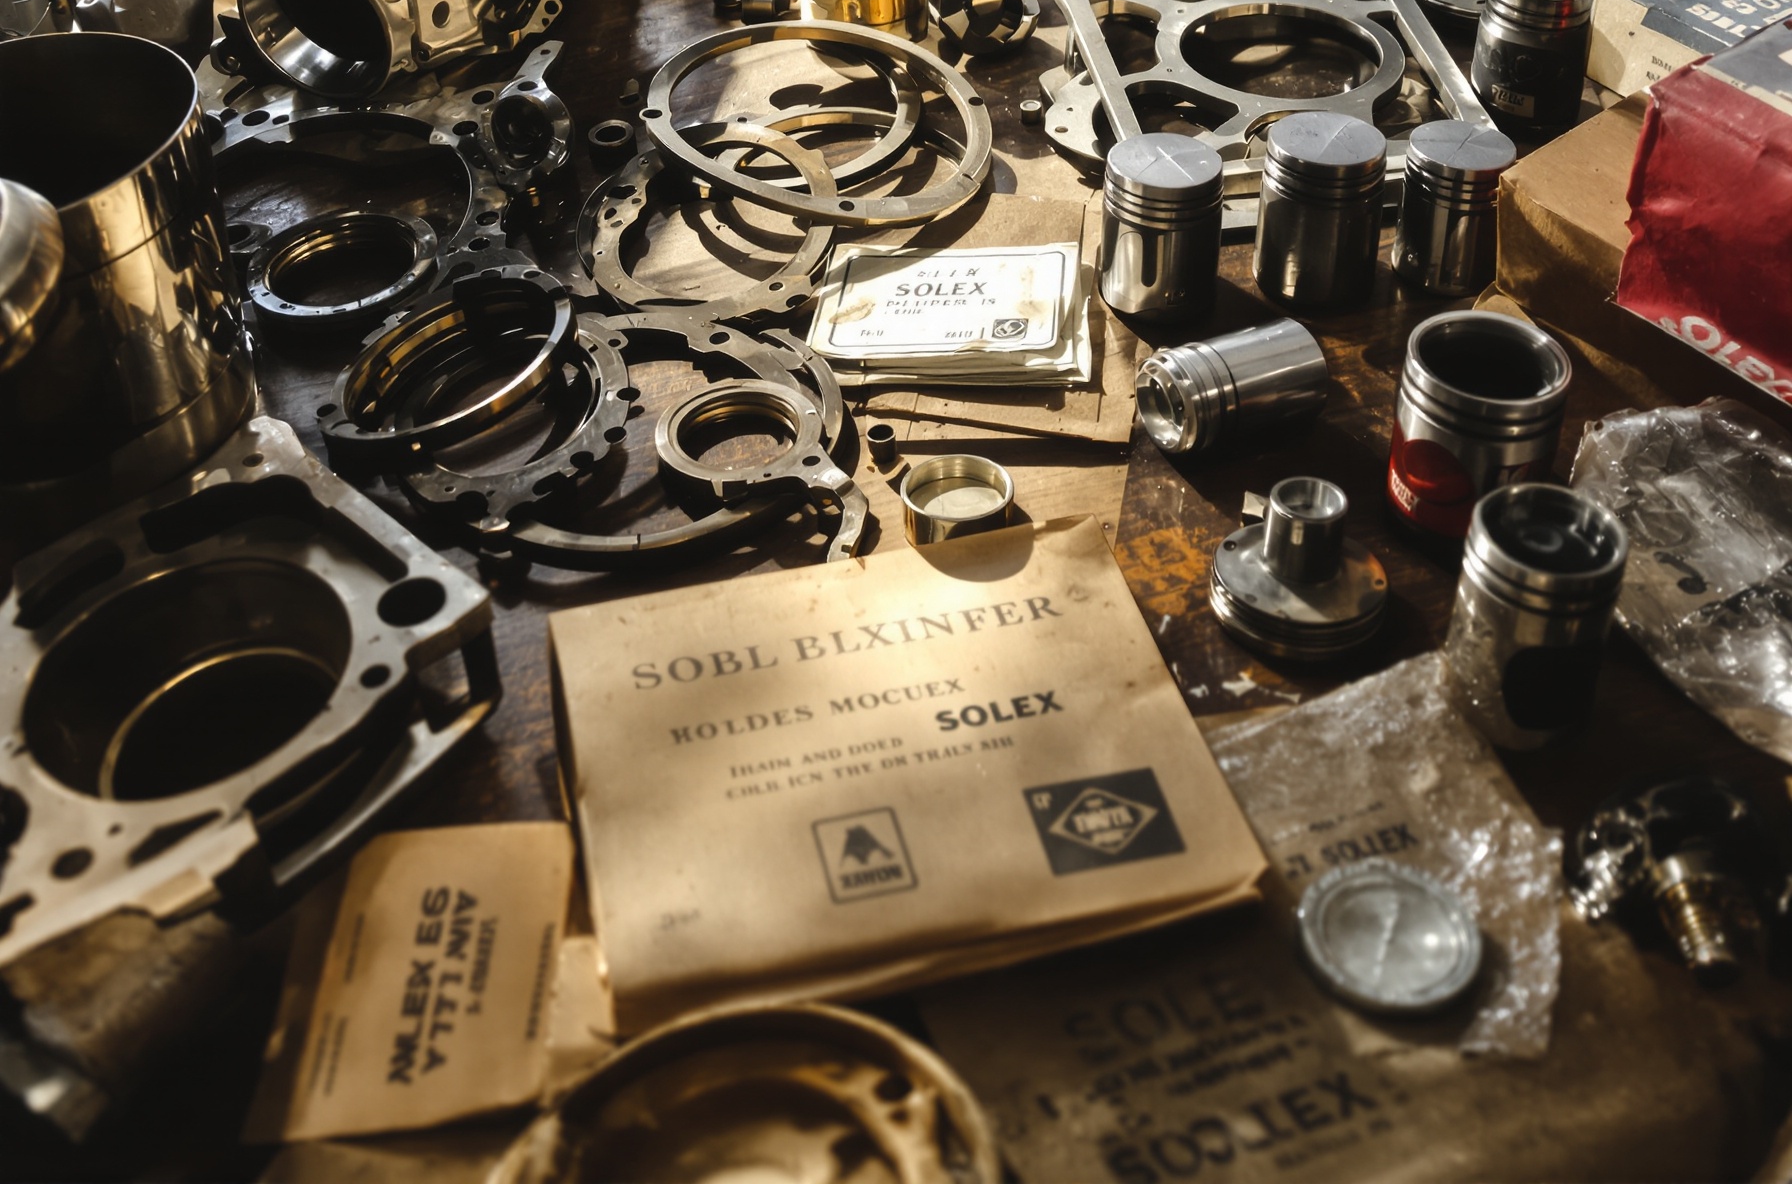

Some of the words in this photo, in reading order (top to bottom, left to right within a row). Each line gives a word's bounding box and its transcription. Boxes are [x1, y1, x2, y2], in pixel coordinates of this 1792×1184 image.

[895, 281, 988, 297] SOLEX
[631, 645, 779, 691] SOBL
[790, 595, 1064, 662] BLXINFER
[828, 677, 966, 716] MOCUEX
[935, 689, 1064, 732] SOLEX
[802, 747, 842, 766] AND
